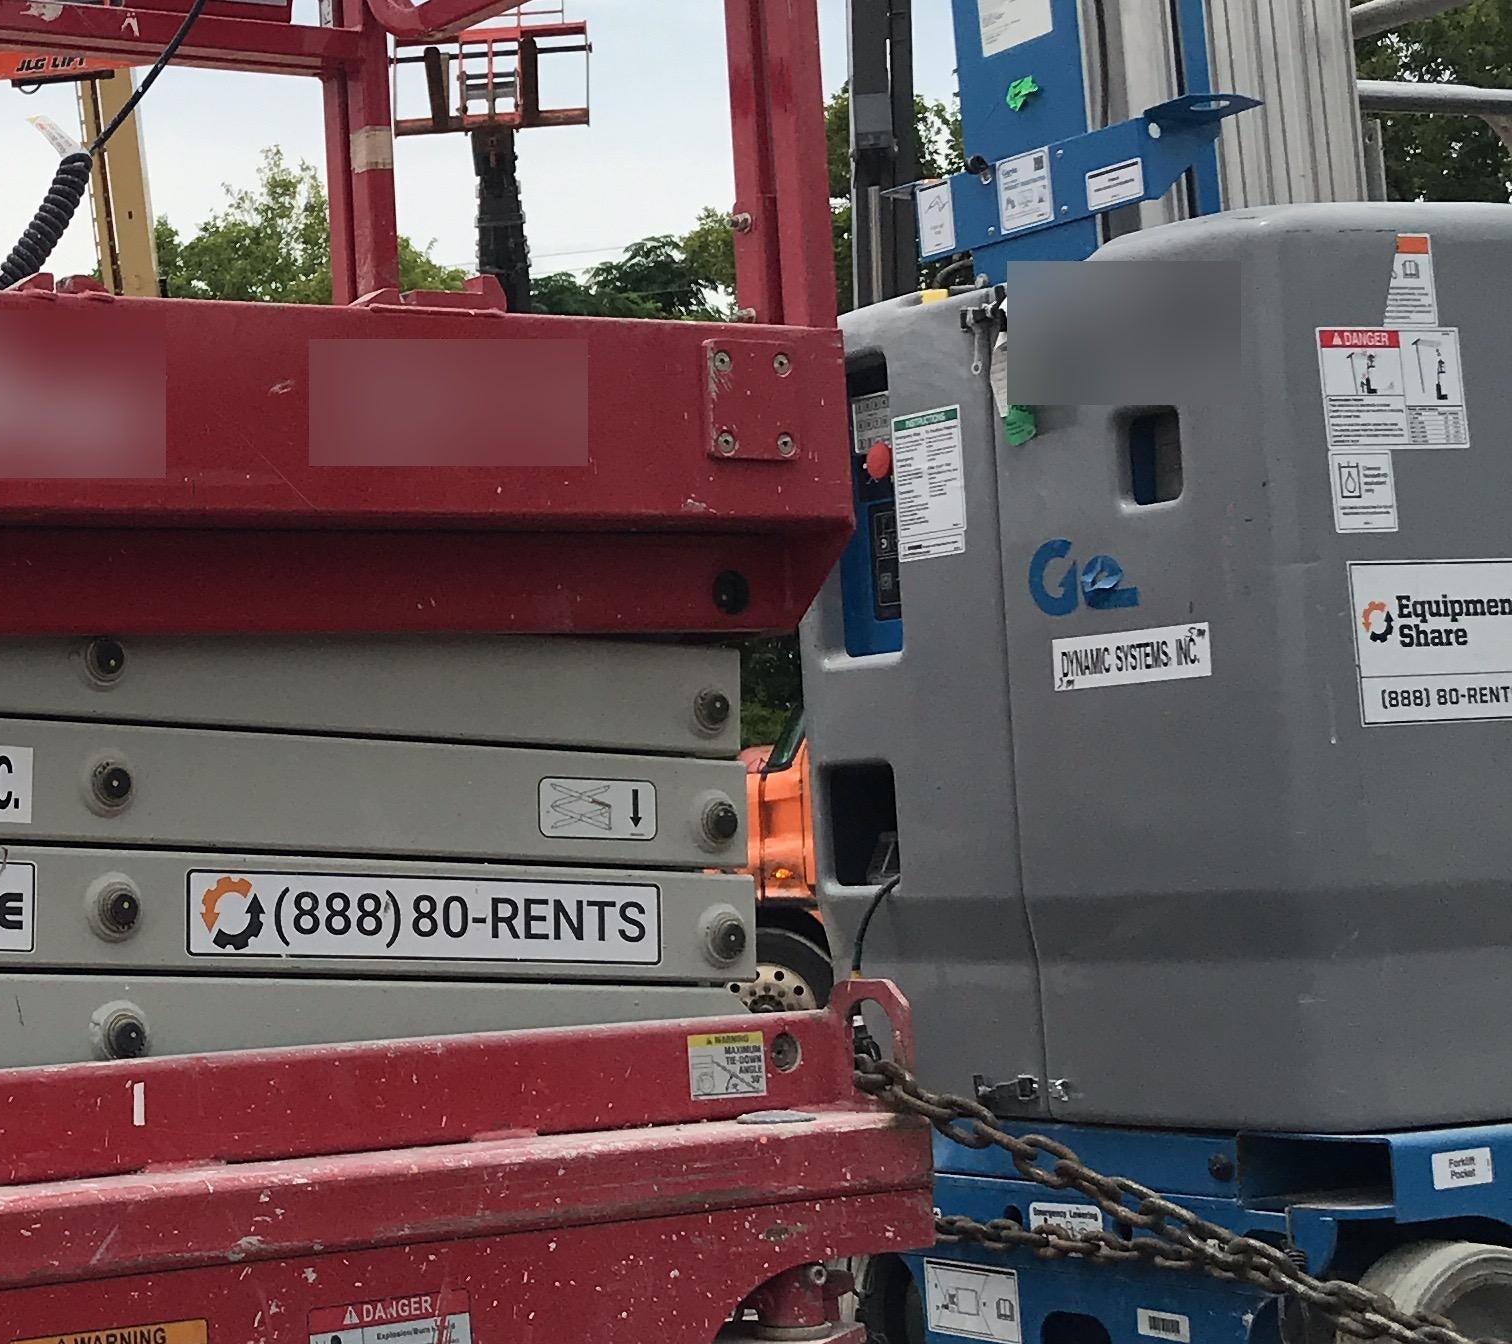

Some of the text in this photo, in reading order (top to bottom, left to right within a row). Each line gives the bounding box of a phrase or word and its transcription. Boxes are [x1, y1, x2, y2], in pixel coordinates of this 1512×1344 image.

[16, 57, 46, 72] JLG
[1344, 331, 1389, 347] DANGER
[1399, 624, 1468, 648] Share
[1061, 647, 1111, 678] DYNAMIC
[1175, 637, 1200, 666] INC.
[1381, 686, 1512, 710] (888) 80-RENT
[363, 1296, 432, 1322] DANGER
